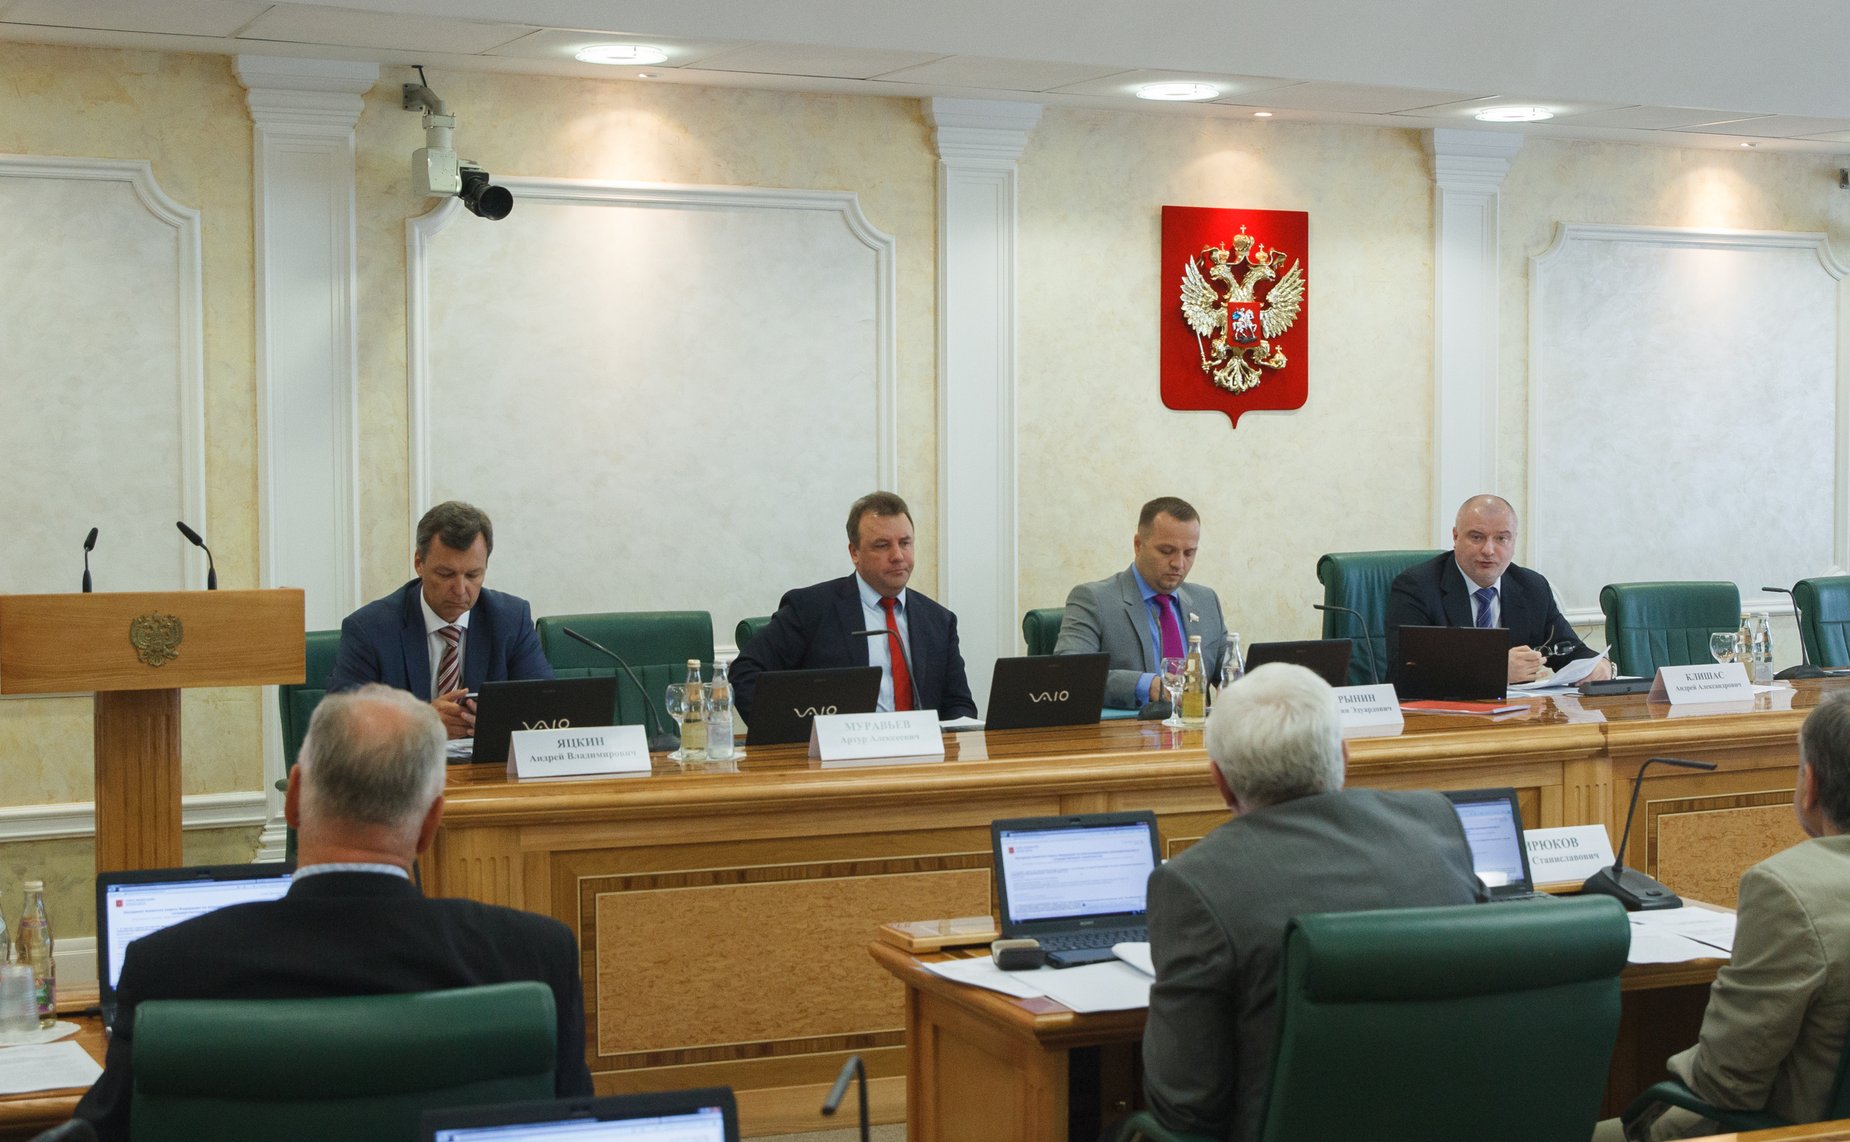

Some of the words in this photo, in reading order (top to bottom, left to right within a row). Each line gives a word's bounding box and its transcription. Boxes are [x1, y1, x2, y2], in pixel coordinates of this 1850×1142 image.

[1685, 671, 1725, 681] КЛИШАС
[1698, 682, 1742, 690] Александрович
[1029, 690, 1070, 703] VAIO
[794, 705, 838, 718] VAIO
[845, 719, 911, 731] МУРАВЬЕВ
[557, 736, 605, 749] ЯЦКИН
[840, 735, 868, 746] Артур
[871, 734, 920, 743] Алексеевич
[529, 752, 565, 763] Андрей
[567, 750, 637, 761] Владимирович
[1532, 853, 1600, 865] Станиславович
